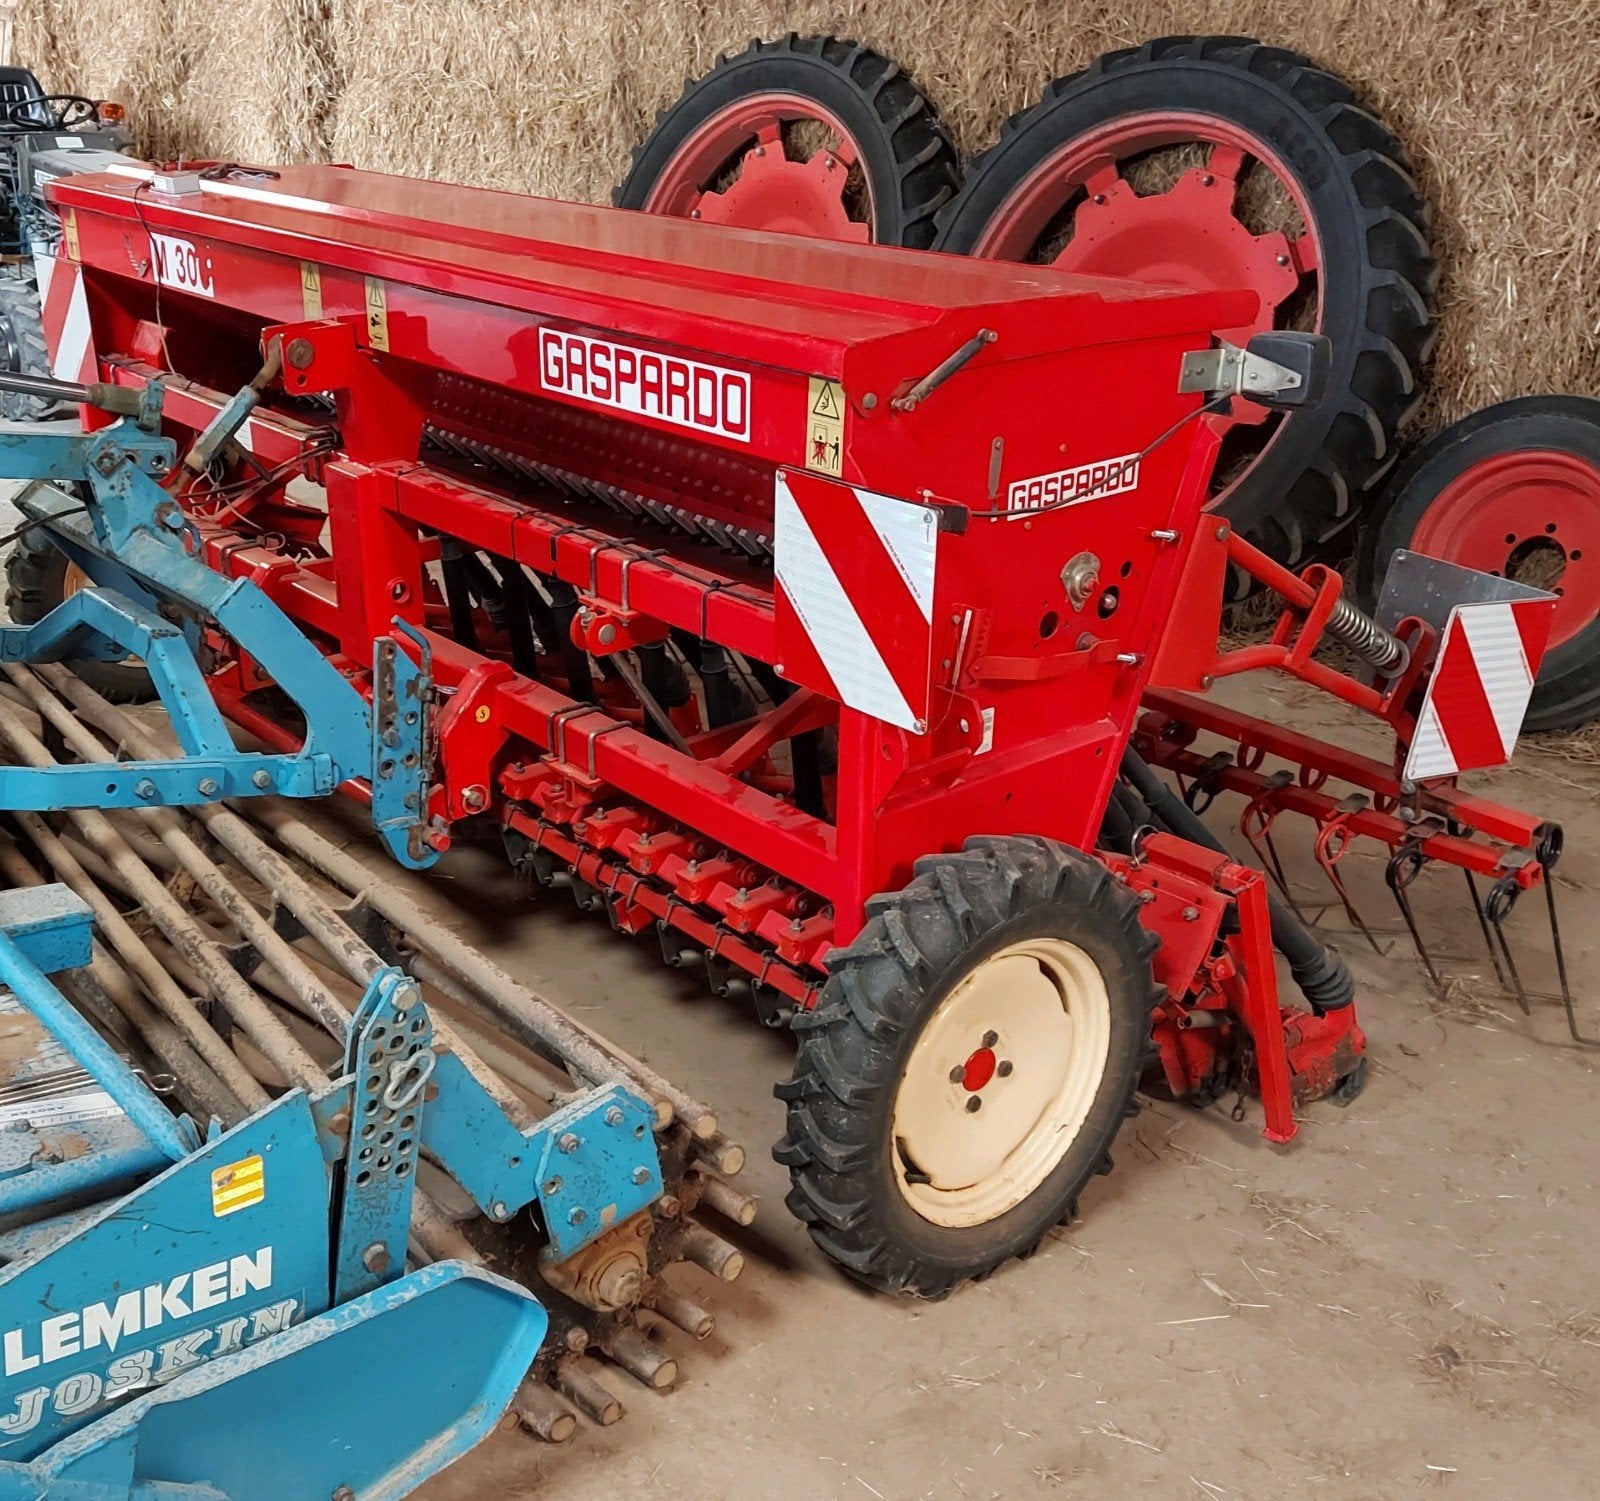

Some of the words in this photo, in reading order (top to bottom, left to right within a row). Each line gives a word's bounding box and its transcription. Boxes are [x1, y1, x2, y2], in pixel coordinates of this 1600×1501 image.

[542, 332, 747, 435] GASPARDO
[1011, 458, 1137, 511] GASPARDO
[0, 1298, 298, 1435] JOSKIN
[3, 1246, 273, 1377] LEMKEN
